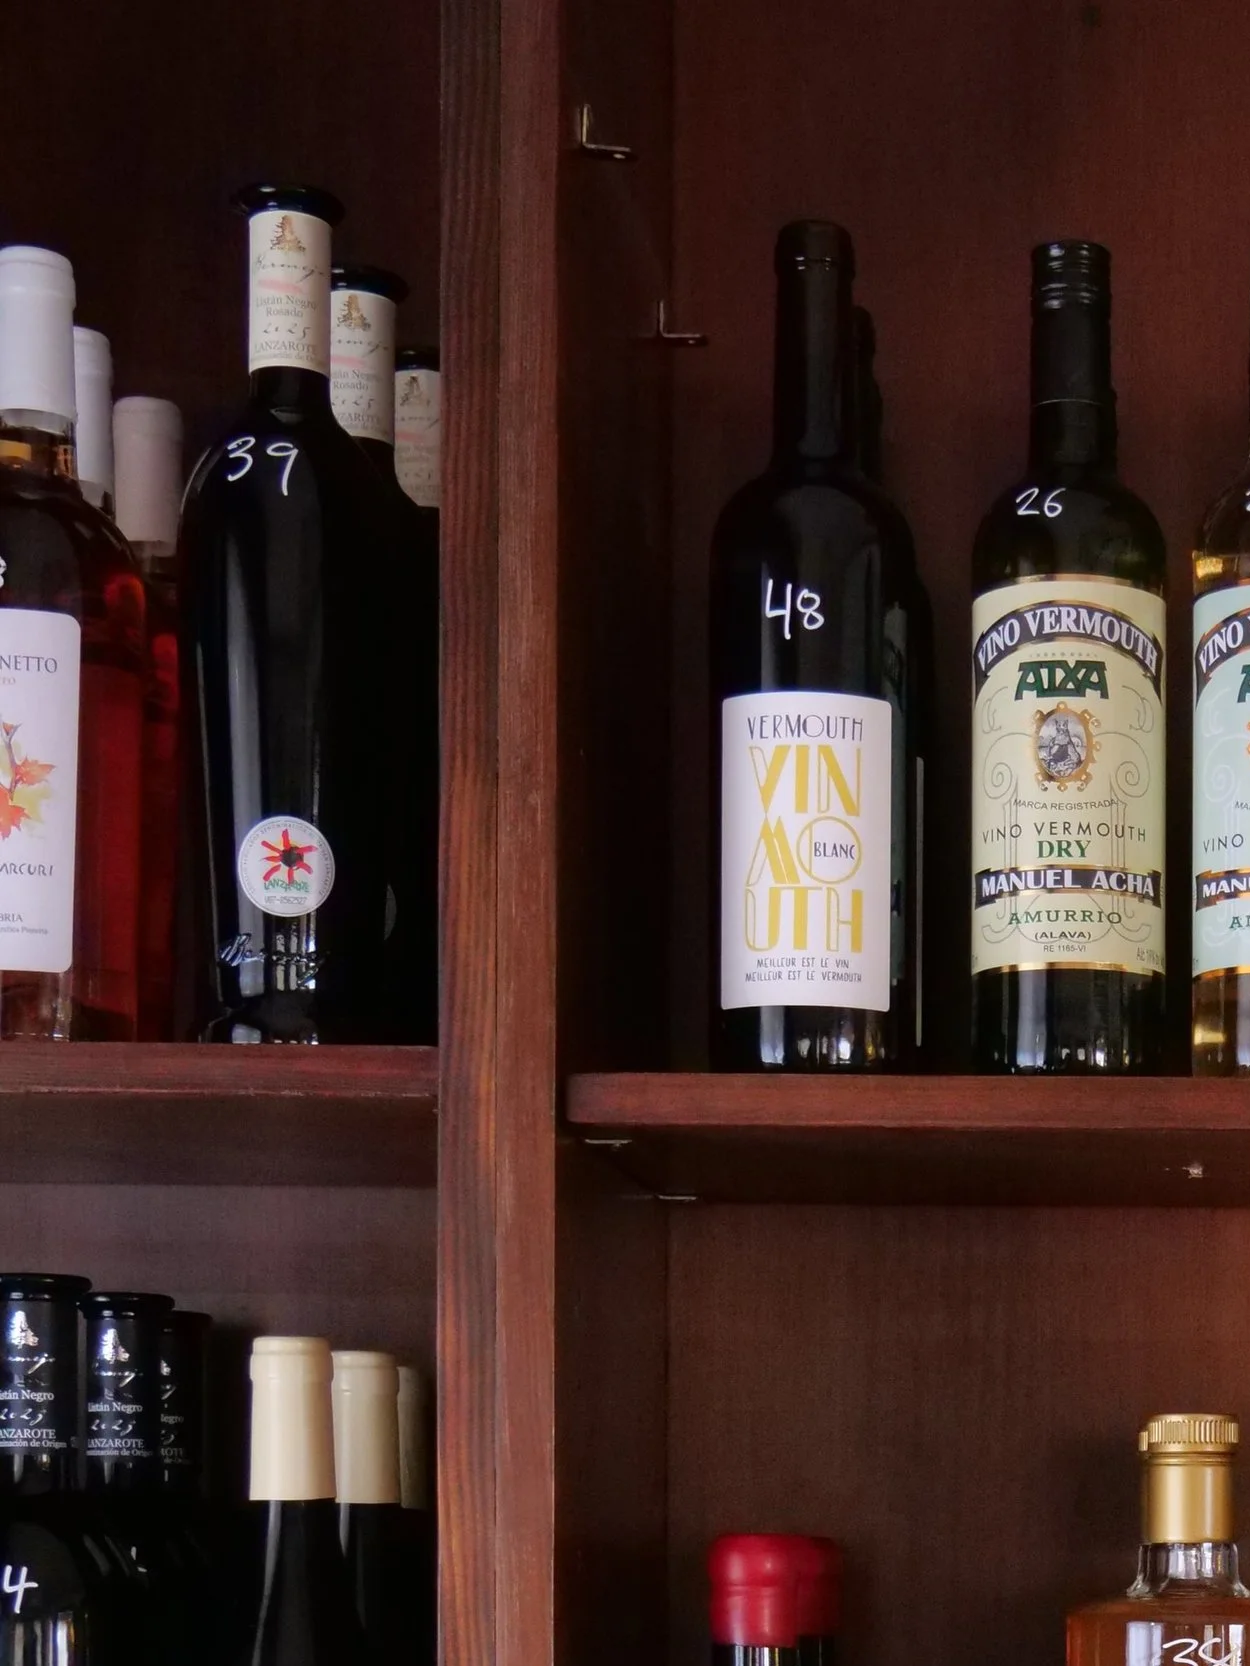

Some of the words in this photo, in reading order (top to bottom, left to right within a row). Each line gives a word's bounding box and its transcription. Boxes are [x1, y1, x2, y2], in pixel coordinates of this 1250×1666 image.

[227, 436, 300, 497] 39
[1015, 487, 1067, 518] 26
[764, 578, 826, 640] 48
[977, 619, 1021, 672] VINO
[1024, 605, 1158, 676] VERMOUTH
[1199, 620, 1243, 675] VINO
[1014, 660, 1109, 700] AIXA
[747, 713, 864, 742] VERMOUTH
[748, 745, 861, 817] VIN
[1013, 798, 1048, 811] MARCA
[1050, 798, 1117, 811] REGISTRADA
[982, 823, 1022, 845] VINO
[1034, 821, 1147, 842] VERMOUTH
[1203, 833, 1244, 853] VINO
[812, 840, 856, 860] BLANC
[1037, 840, 1092, 859] DRY
[981, 869, 1081, 898] MANUEL
[1091, 870, 1154, 897] ACHA
[1008, 909, 1122, 926] AMURRIO
[1034, 930, 1092, 941] (ALAVA)
[757, 957, 797, 970] MEILLEUR
[802, 957, 817, 970] EST
[820, 957, 829, 970] LE
[834, 958, 850, 970] VIN
[745, 971, 783, 983] MEILLEUR
[787, 971, 801, 983] EST
[806, 971, 816, 983] LE
[821, 971, 863, 984] VERMOUTH
[21, 1389, 55, 1402] Negro
[112, 1402, 143, 1414] Negro
[30, 1440, 41, 1448] de
